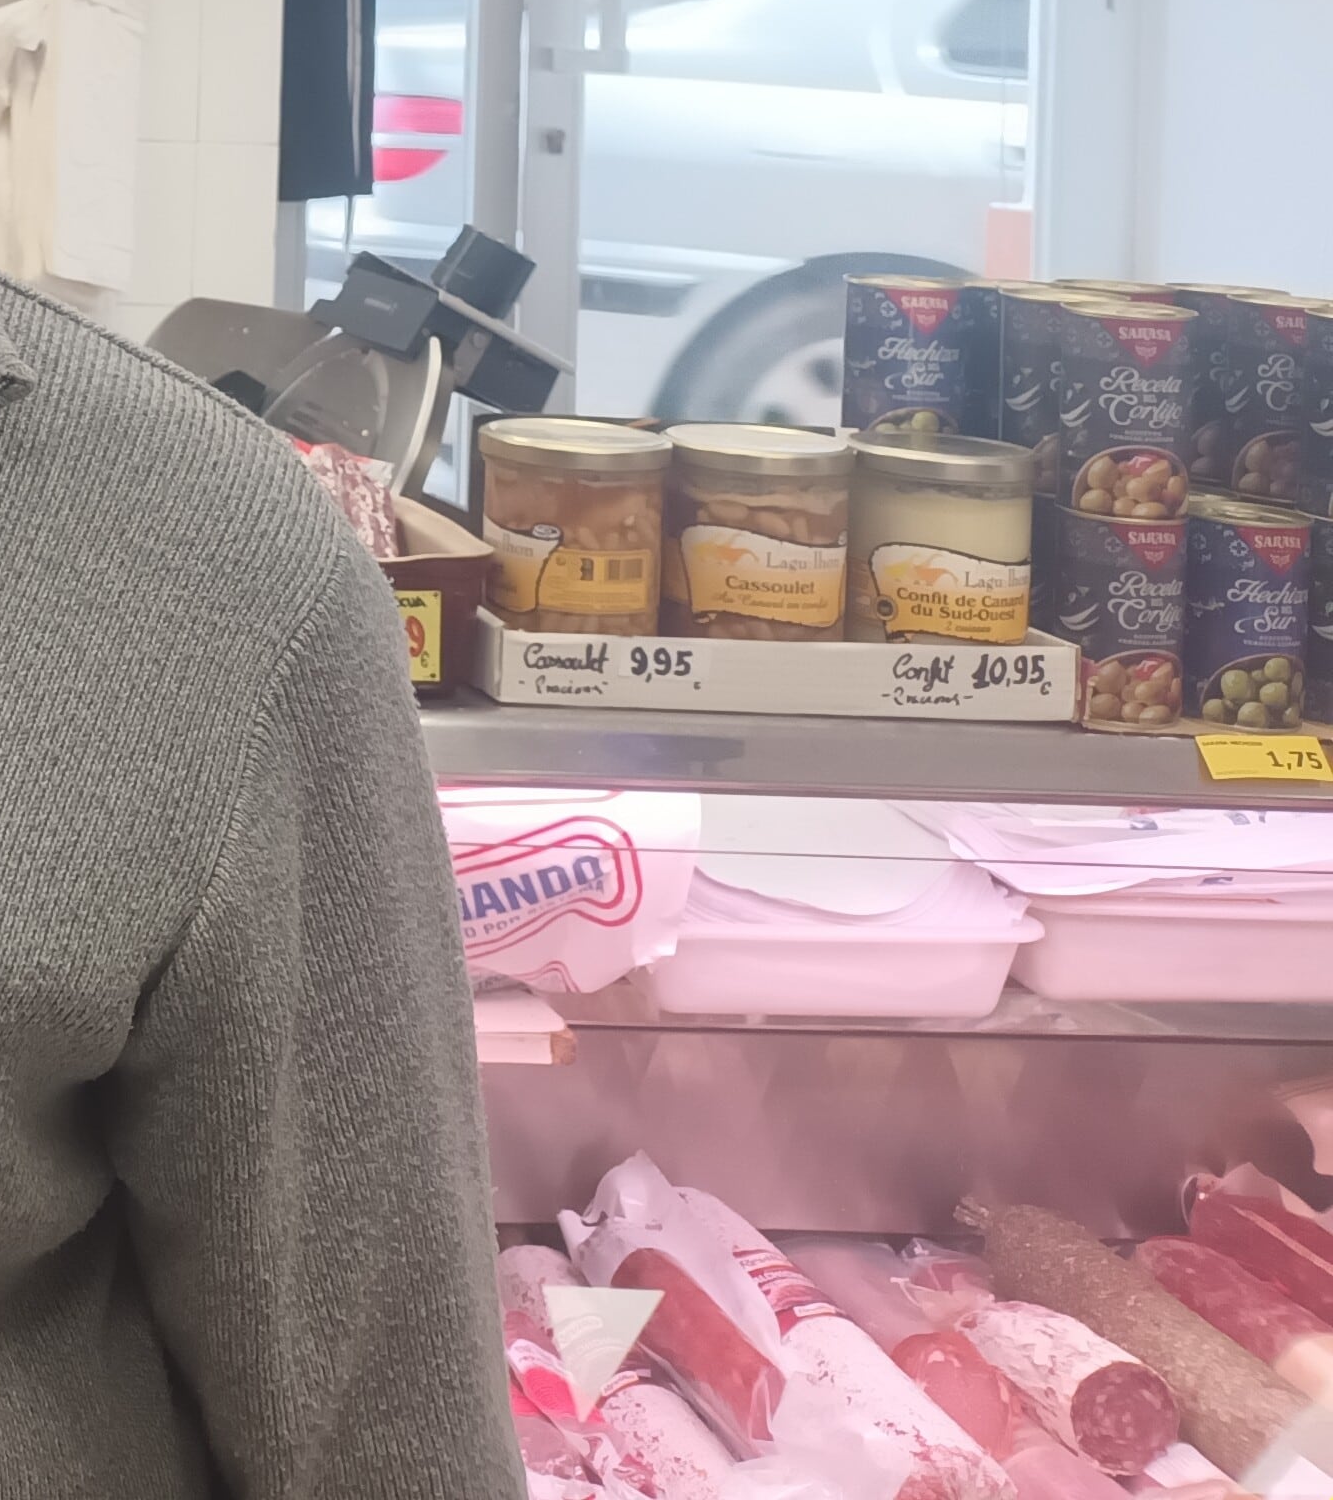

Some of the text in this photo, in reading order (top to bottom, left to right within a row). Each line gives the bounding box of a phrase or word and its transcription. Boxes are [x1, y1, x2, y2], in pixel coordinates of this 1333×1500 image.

[1118, 326, 1172, 342] SARASA
[1274, 314, 1306, 330] SAR
[901, 362, 945, 388] Sur
[1257, 353, 1301, 379] Re
[1099, 366, 1183, 393] Receta
[1256, 379, 1301, 411] Co
[1098, 393, 1184, 428] Cortijo
[1127, 531, 1176, 546] SARASA
[1254, 534, 1302, 550] SARASA
[724, 575, 815, 596] Cassoulet
[896, 586, 950, 606] Confit
[955, 593, 977, 607] de
[1108, 570, 1183, 598] Receta
[910, 604, 1016, 622] du Sud-Ouest
[1107, 598, 1183, 634] Cortijo
[1253, 605, 1296, 632] Sur
[404, 615, 426, 657] 9
[630, 646, 694, 683] 9,95
[971, 653, 1046, 690] 10,95
[1265, 750, 1323, 771] 1,75
